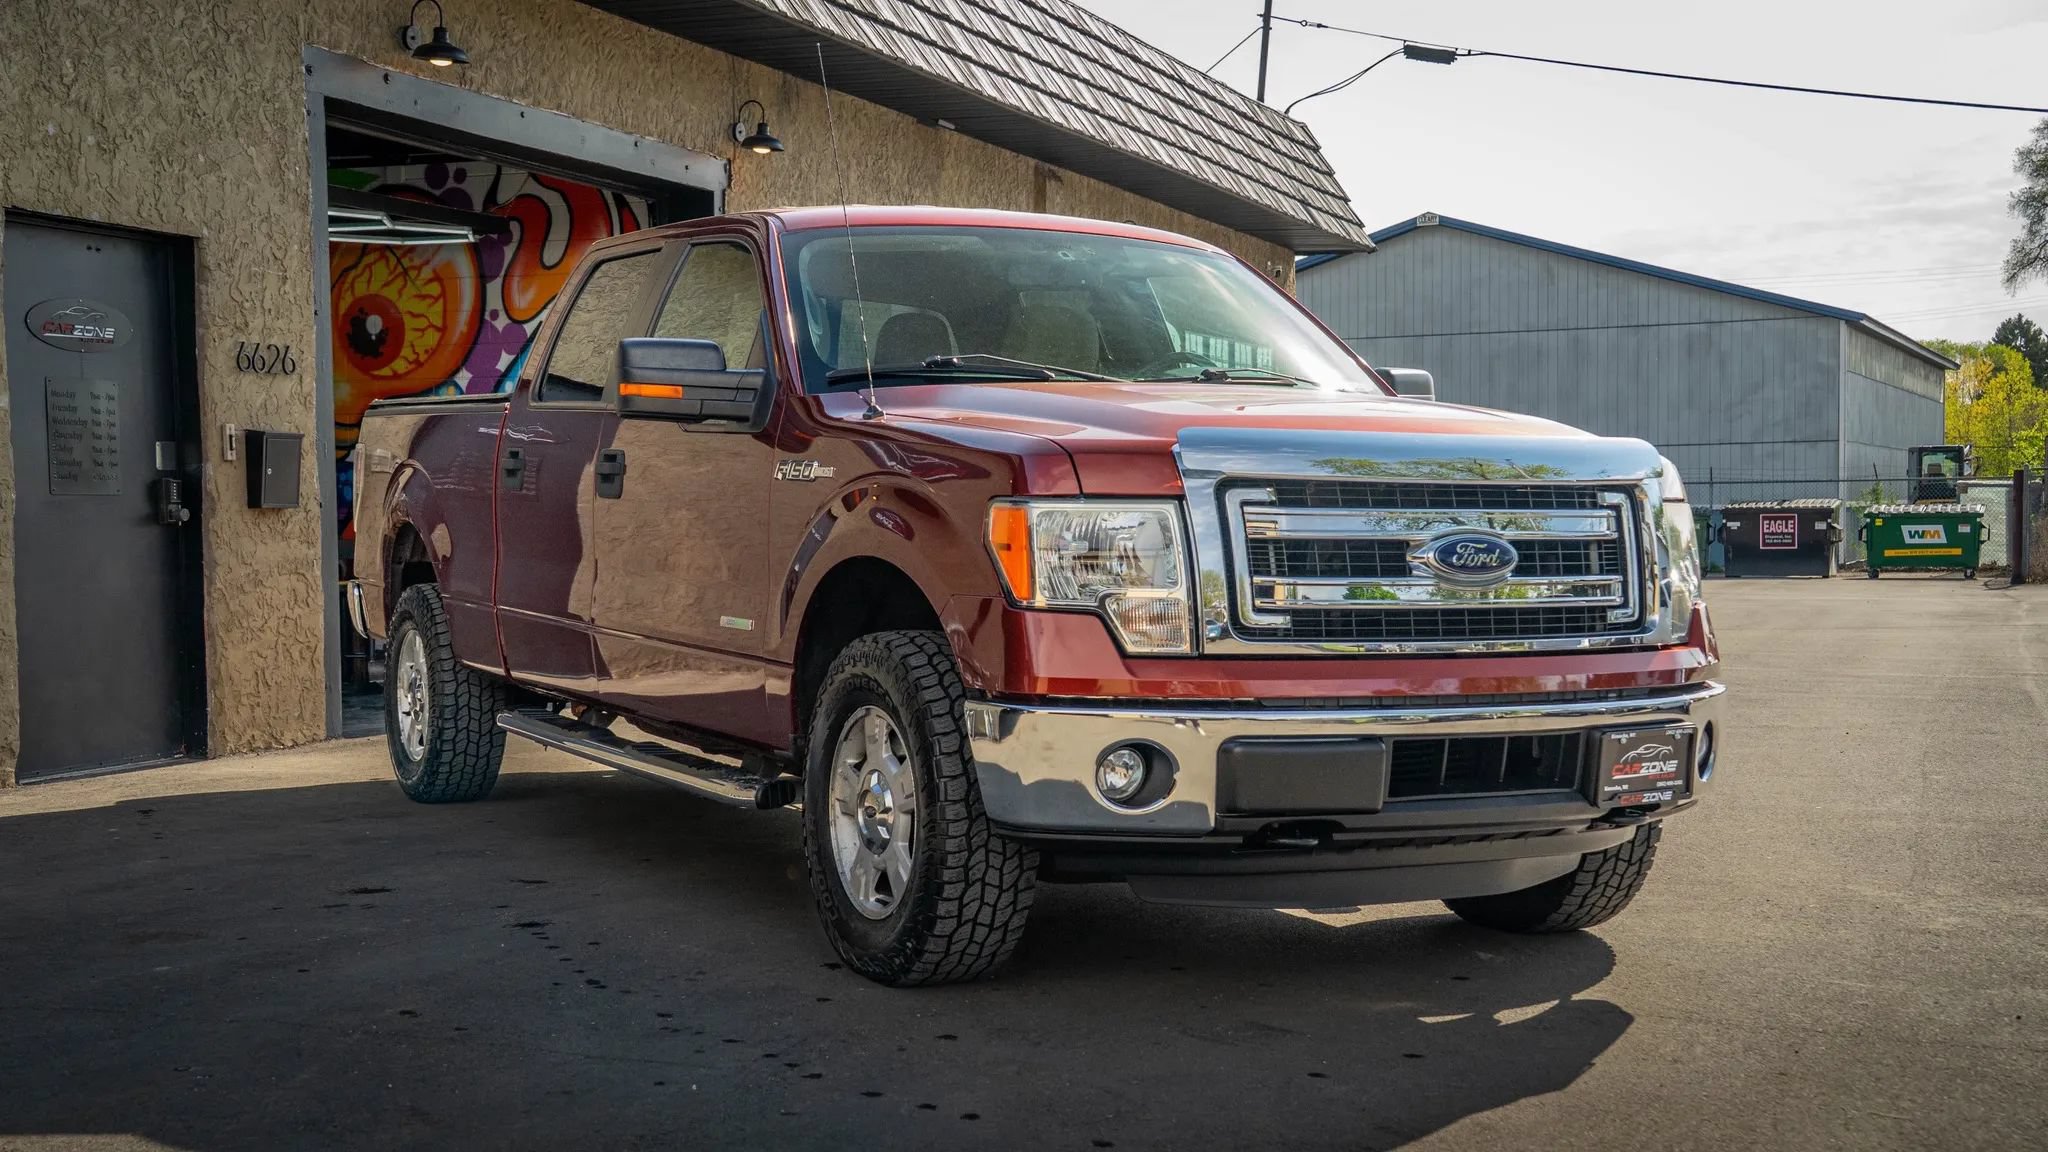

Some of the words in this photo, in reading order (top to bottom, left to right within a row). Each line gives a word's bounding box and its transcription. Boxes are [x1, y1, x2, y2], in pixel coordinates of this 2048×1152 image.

[236, 341, 296, 376] 6626
[1763, 520, 1794, 533] EAGLE
[1908, 529, 1941, 539] WM
[1452, 542, 1500, 567] Ford
[1611, 760, 1678, 776] CARZONE
[1620, 791, 1673, 805] CARZONE
